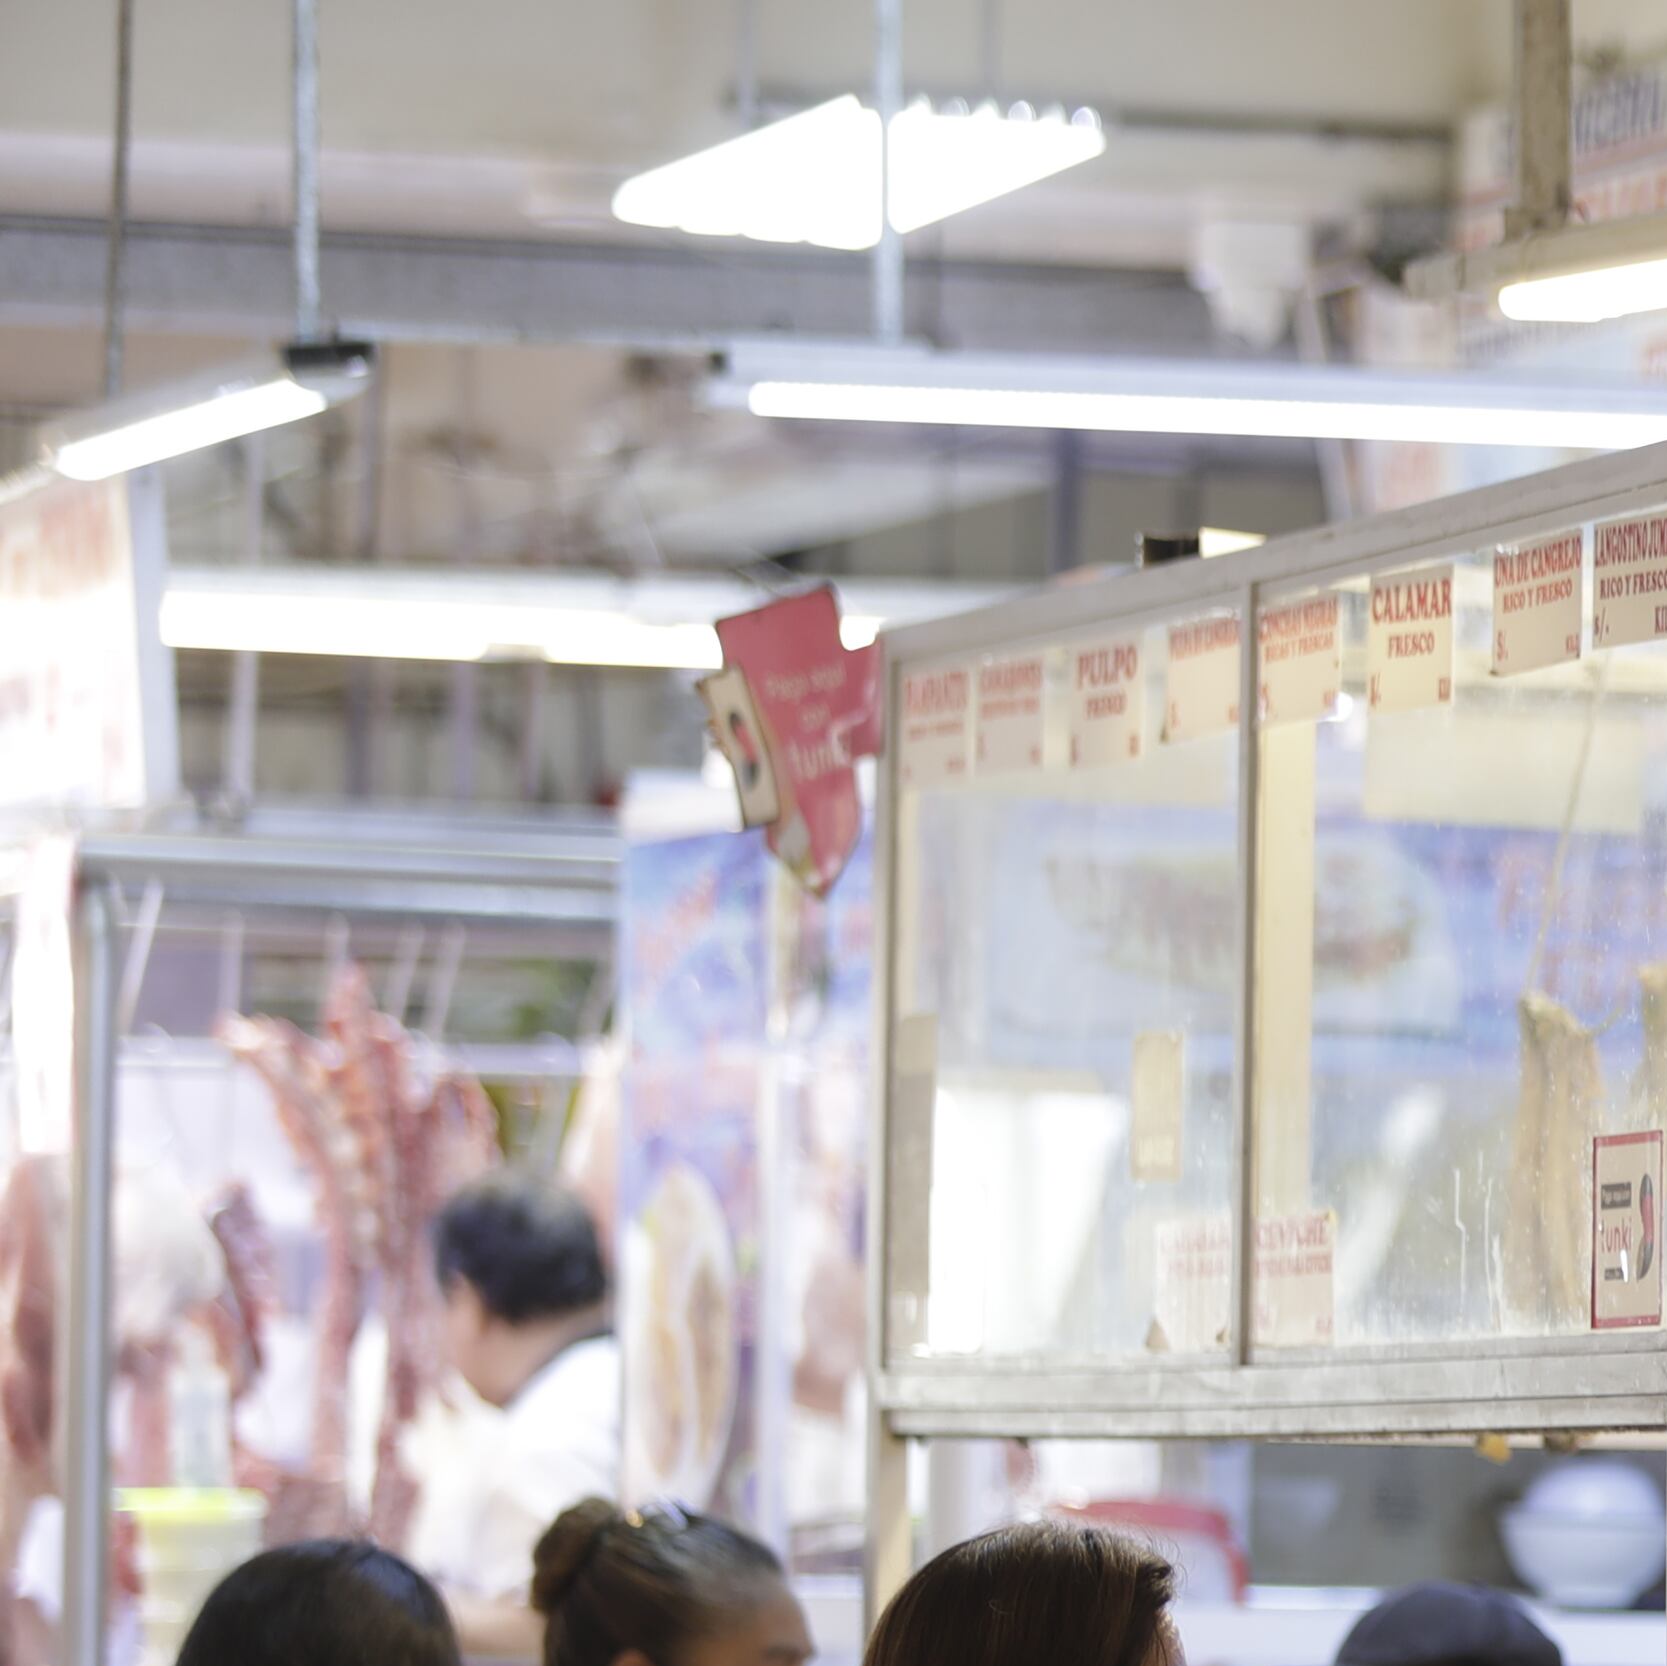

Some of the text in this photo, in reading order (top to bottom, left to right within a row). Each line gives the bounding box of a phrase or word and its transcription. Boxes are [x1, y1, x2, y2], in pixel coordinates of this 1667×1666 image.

[1517, 548, 1531, 583] DE
[1531, 535, 1581, 578] CANGREJO
[1595, 521, 1648, 568] LANGOSTINO
[1372, 577, 1452, 623] CALAMAR
[1503, 577, 1573, 614] RICO Y FRESCO
[1600, 577, 1623, 600] RICO
[1624, 575, 1632, 596] Y
[1388, 632, 1435, 659] FRESCO
[1077, 645, 1138, 690] PULPO
[1601, 1217, 1632, 1255] tunki
